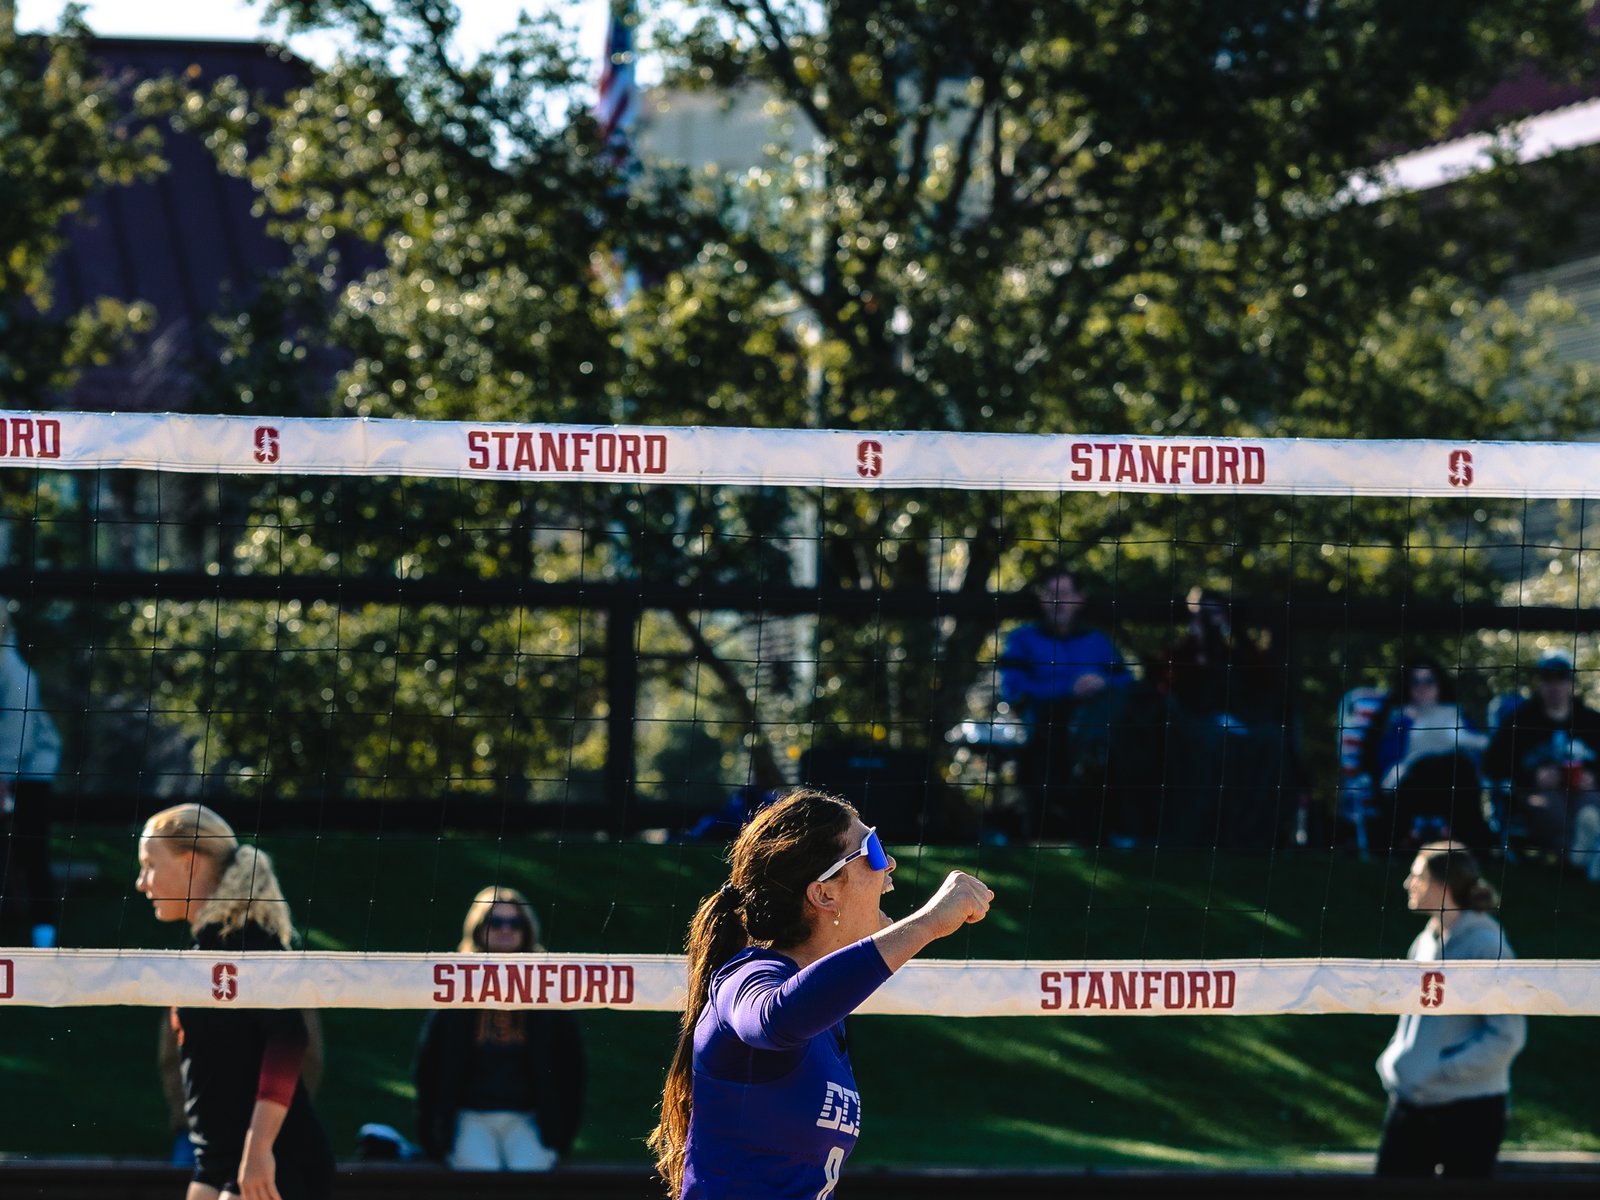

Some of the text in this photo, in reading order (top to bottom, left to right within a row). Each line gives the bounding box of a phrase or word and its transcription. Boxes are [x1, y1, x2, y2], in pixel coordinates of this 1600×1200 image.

[254, 426, 279, 463] S
[468, 431, 667, 474] STANFORD
[857, 440, 882, 478] S
[1070, 443, 1265, 485] STANFORD
[1448, 450, 1472, 487] S
[212, 962, 238, 1001] S
[433, 964, 634, 1005] STANFORD
[1040, 971, 1236, 1011] STANFORD
[1420, 972, 1445, 1008] S
